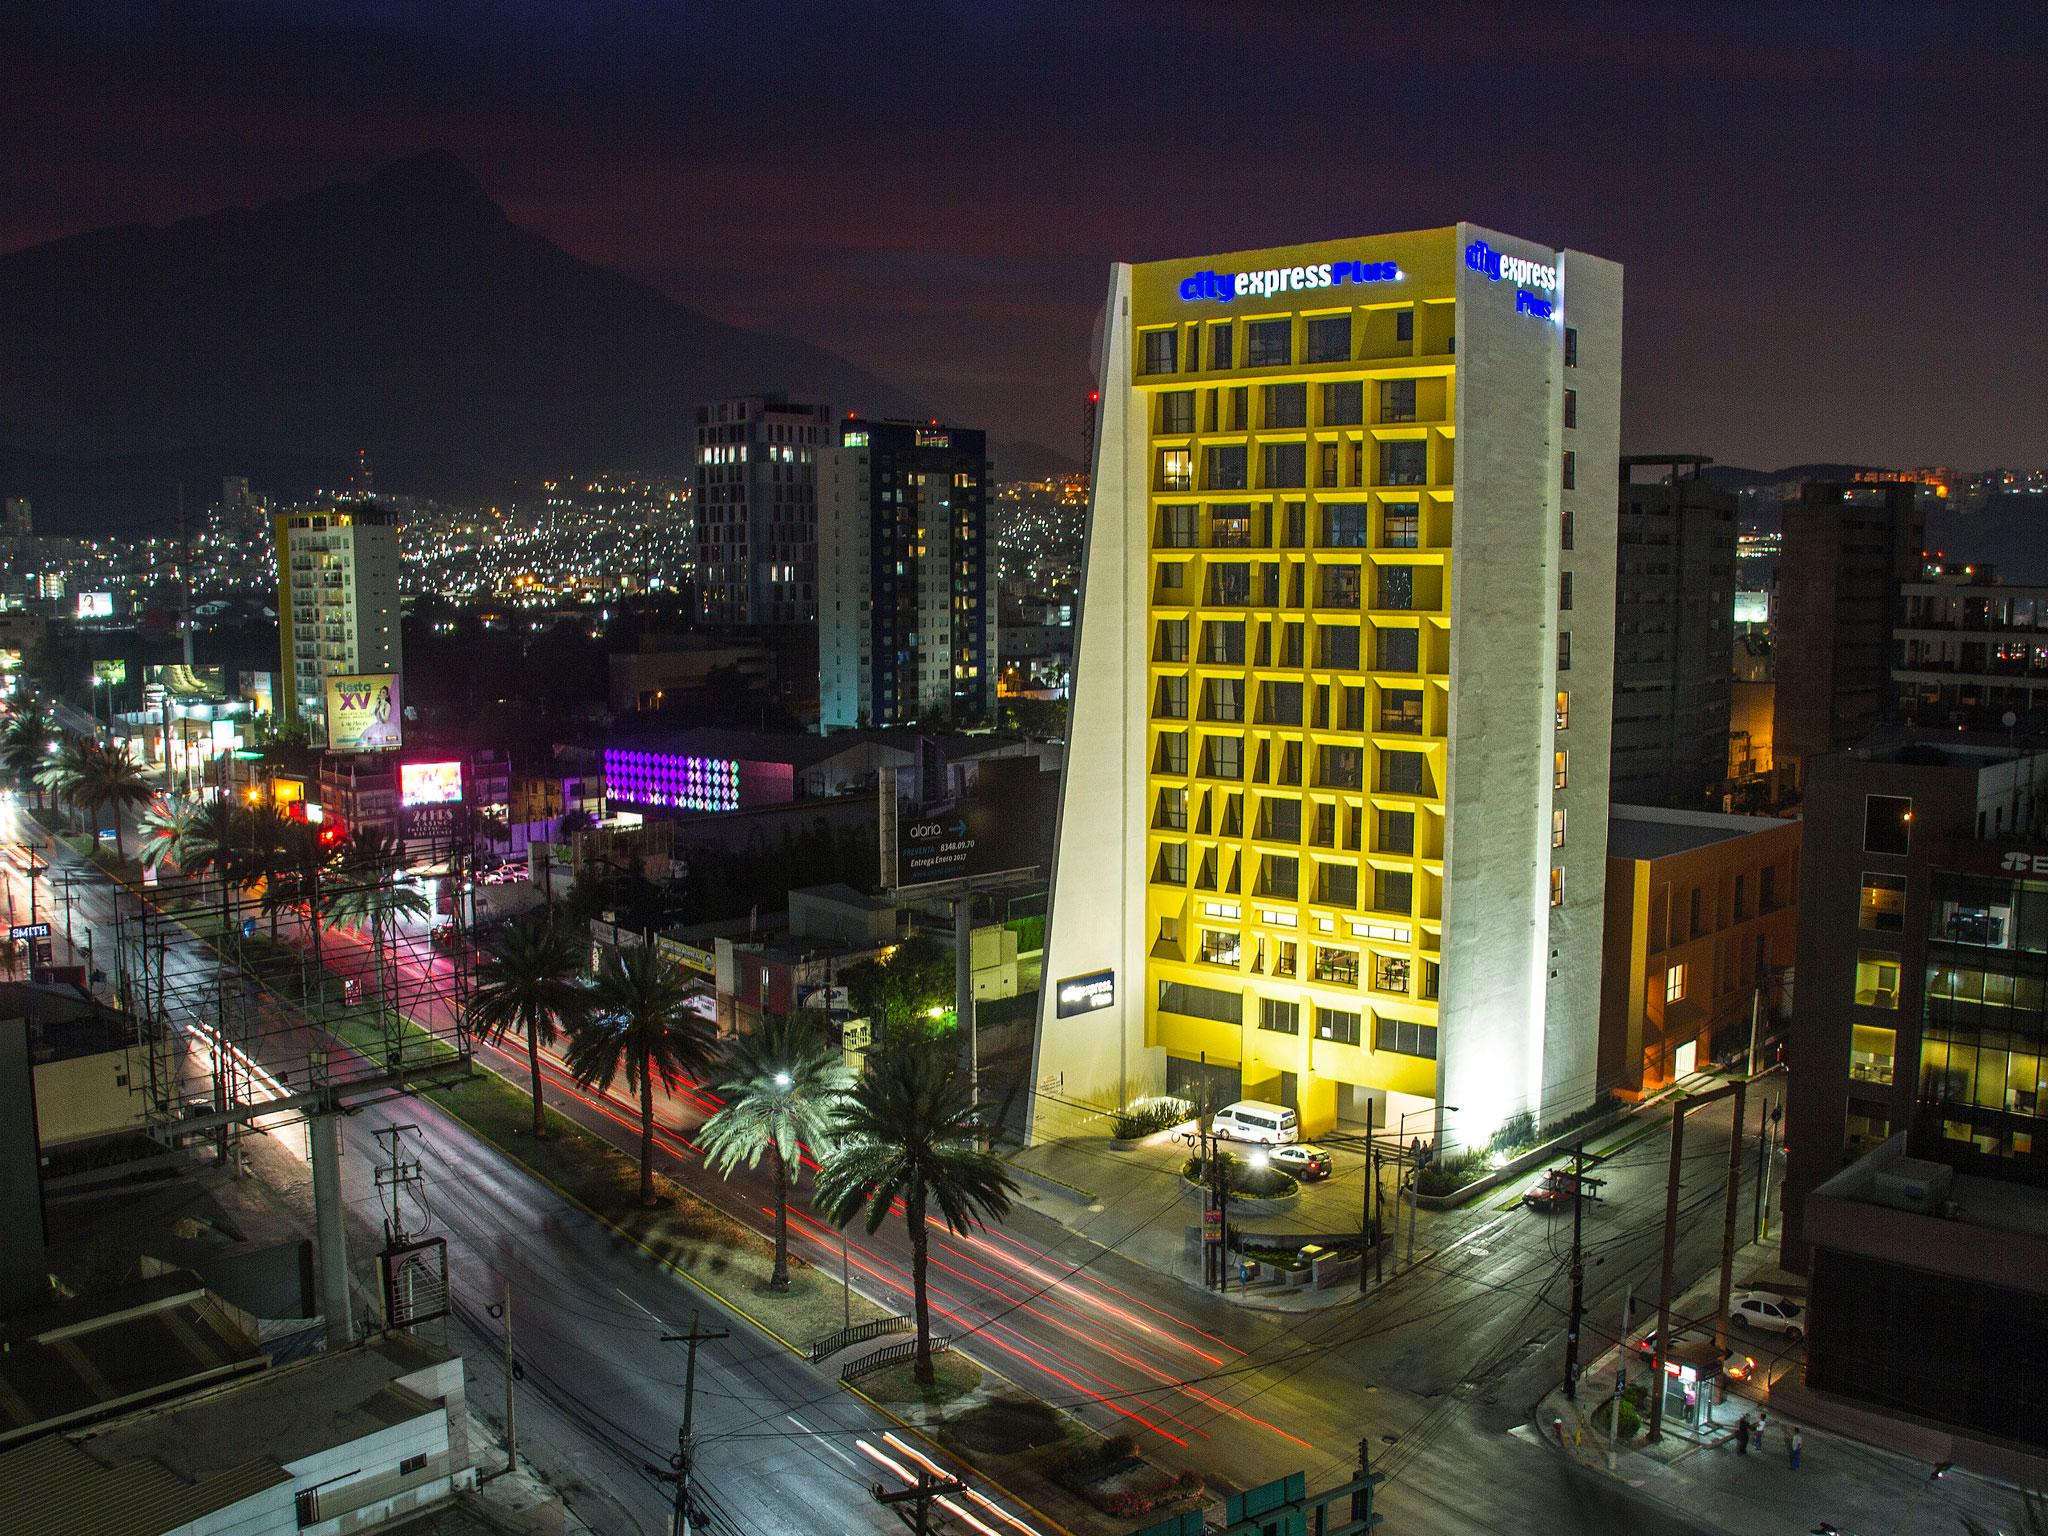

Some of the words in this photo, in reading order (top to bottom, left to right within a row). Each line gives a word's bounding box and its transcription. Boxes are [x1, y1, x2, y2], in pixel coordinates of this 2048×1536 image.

[339, 692, 371, 711] XV
[911, 858, 934, 867] Entrega
[935, 856, 952, 864] Enero
[953, 853, 967, 862] 2017
[12, 925, 48, 938] SMITH
